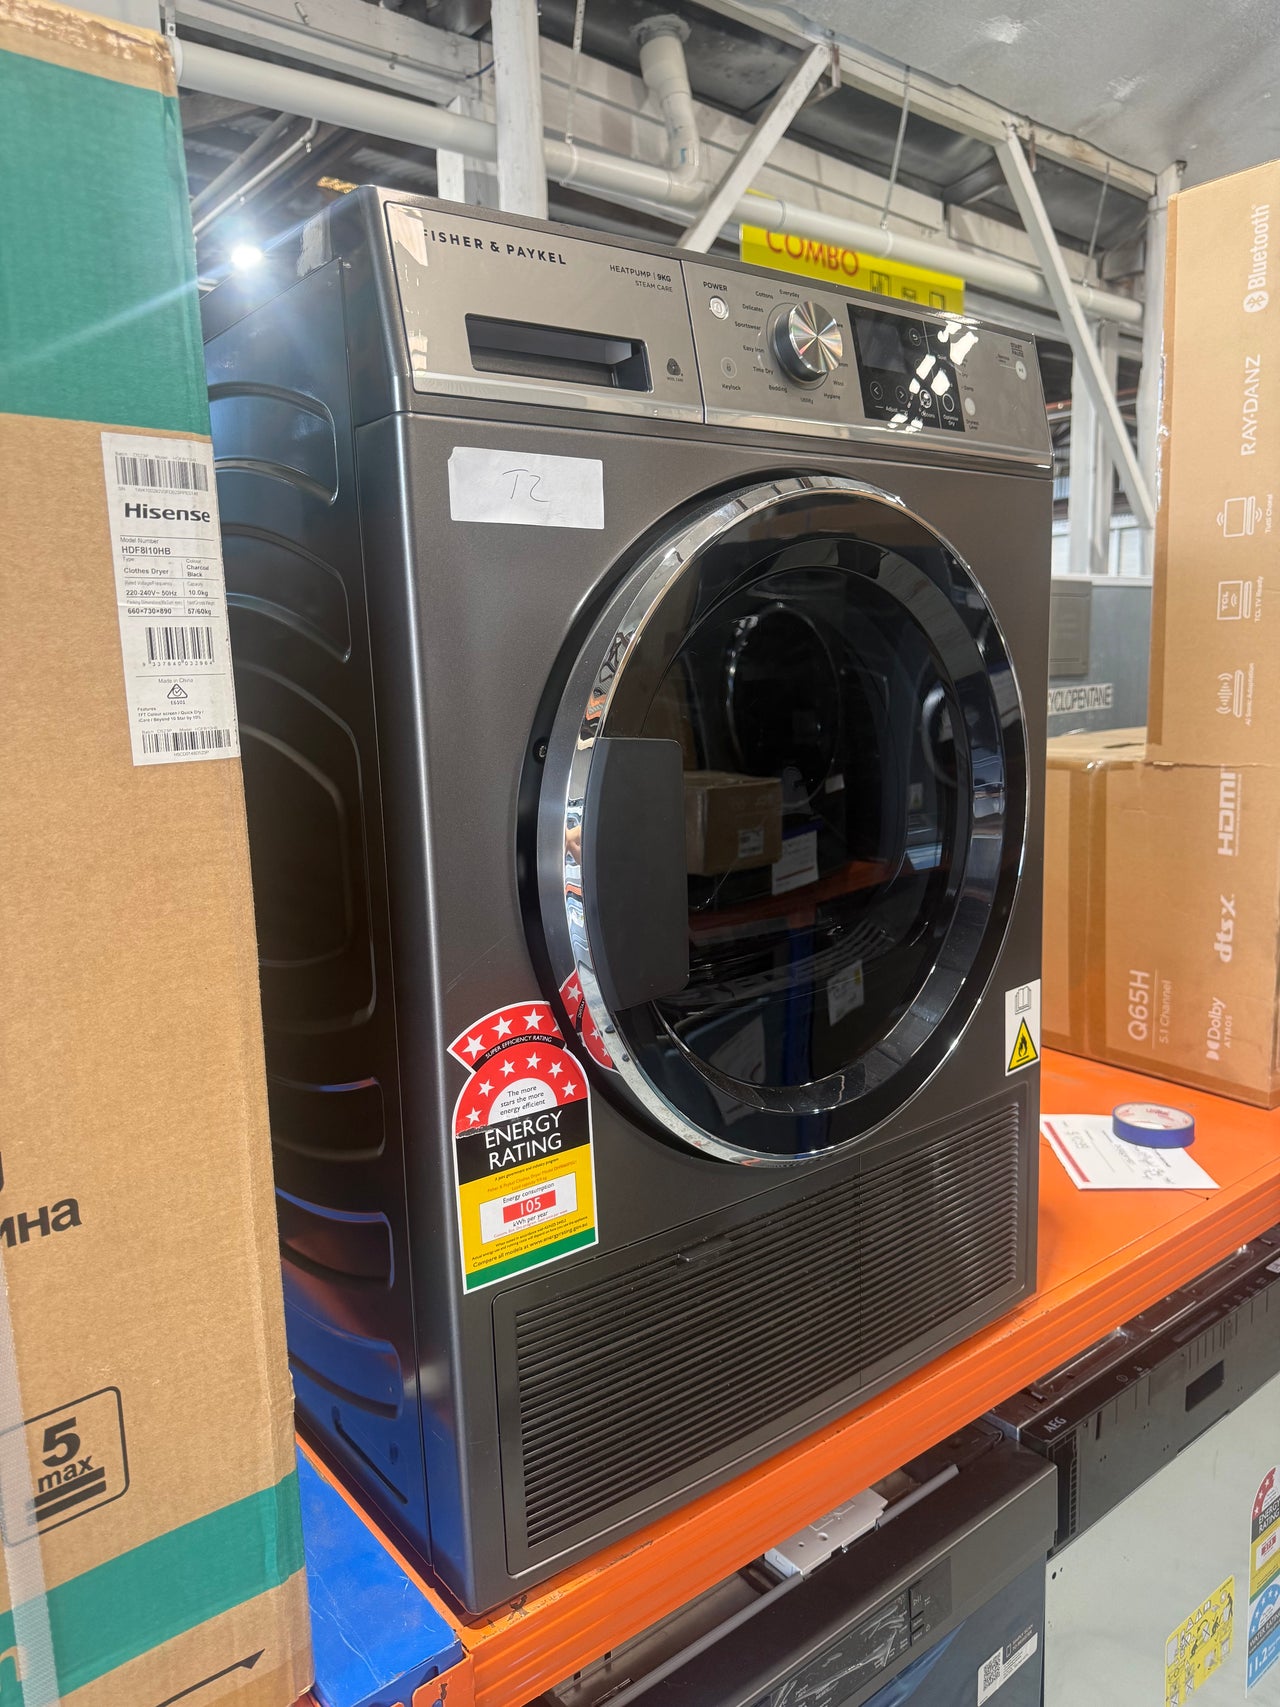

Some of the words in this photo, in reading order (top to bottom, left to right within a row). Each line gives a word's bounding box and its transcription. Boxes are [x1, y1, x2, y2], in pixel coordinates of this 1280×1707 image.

[490, 240, 500, 253] &
[506, 243, 566, 265] PAYKEL
[766, 230, 860, 277] COMBO
[1247, 203, 1269, 290] Bluetooth
[609, 264, 651, 278] HEATPUMP
[656, 272, 672, 282] 9KG
[635, 280, 656, 289] STEAM
[656, 284, 673, 292] CARE
[703, 281, 728, 292] POWER
[755, 291, 774, 300] Cottons
[742, 304, 764, 312] Delicates
[734, 321, 761, 330] Sportswear
[124, 502, 211, 523] Hisense
[1218, 772, 1236, 856] HDMI
[1128, 969, 1150, 1041] Q65H
[1160, 980, 1172, 1027] Channel
[1207, 996, 1227, 1040] Dolby
[1158, 1028, 1168, 1044] 5.1
[1224, 1015, 1233, 1048] ATMOS
[485, 1046, 502, 1059] SUPER
[502, 1035, 532, 1048] EFFICIENCY
[532, 1034, 552, 1042] RATING
[500, 1100, 516, 1108] stars
[528, 1092, 544, 1100] more
[520, 1086, 537, 1095] more
[500, 1106, 520, 1116] energy
[522, 1099, 546, 1110] efficient
[484, 1110, 562, 1149] ENERGY
[488, 1132, 562, 1170] RATING
[502, 1194, 521, 1204] Energy
[522, 1182, 554, 1198] consumption
[520, 1196, 542, 1216] 105
[512, 1218, 526, 1227] kWh
[537, 1210, 549, 1220] year
[473, 1256, 497, 1268] Compare
[505, 1247, 523, 1257] models
[1044, 1416, 1067, 1434] AEG
[42, 1416, 80, 1467] 5
[38, 1455, 94, 1494] max
